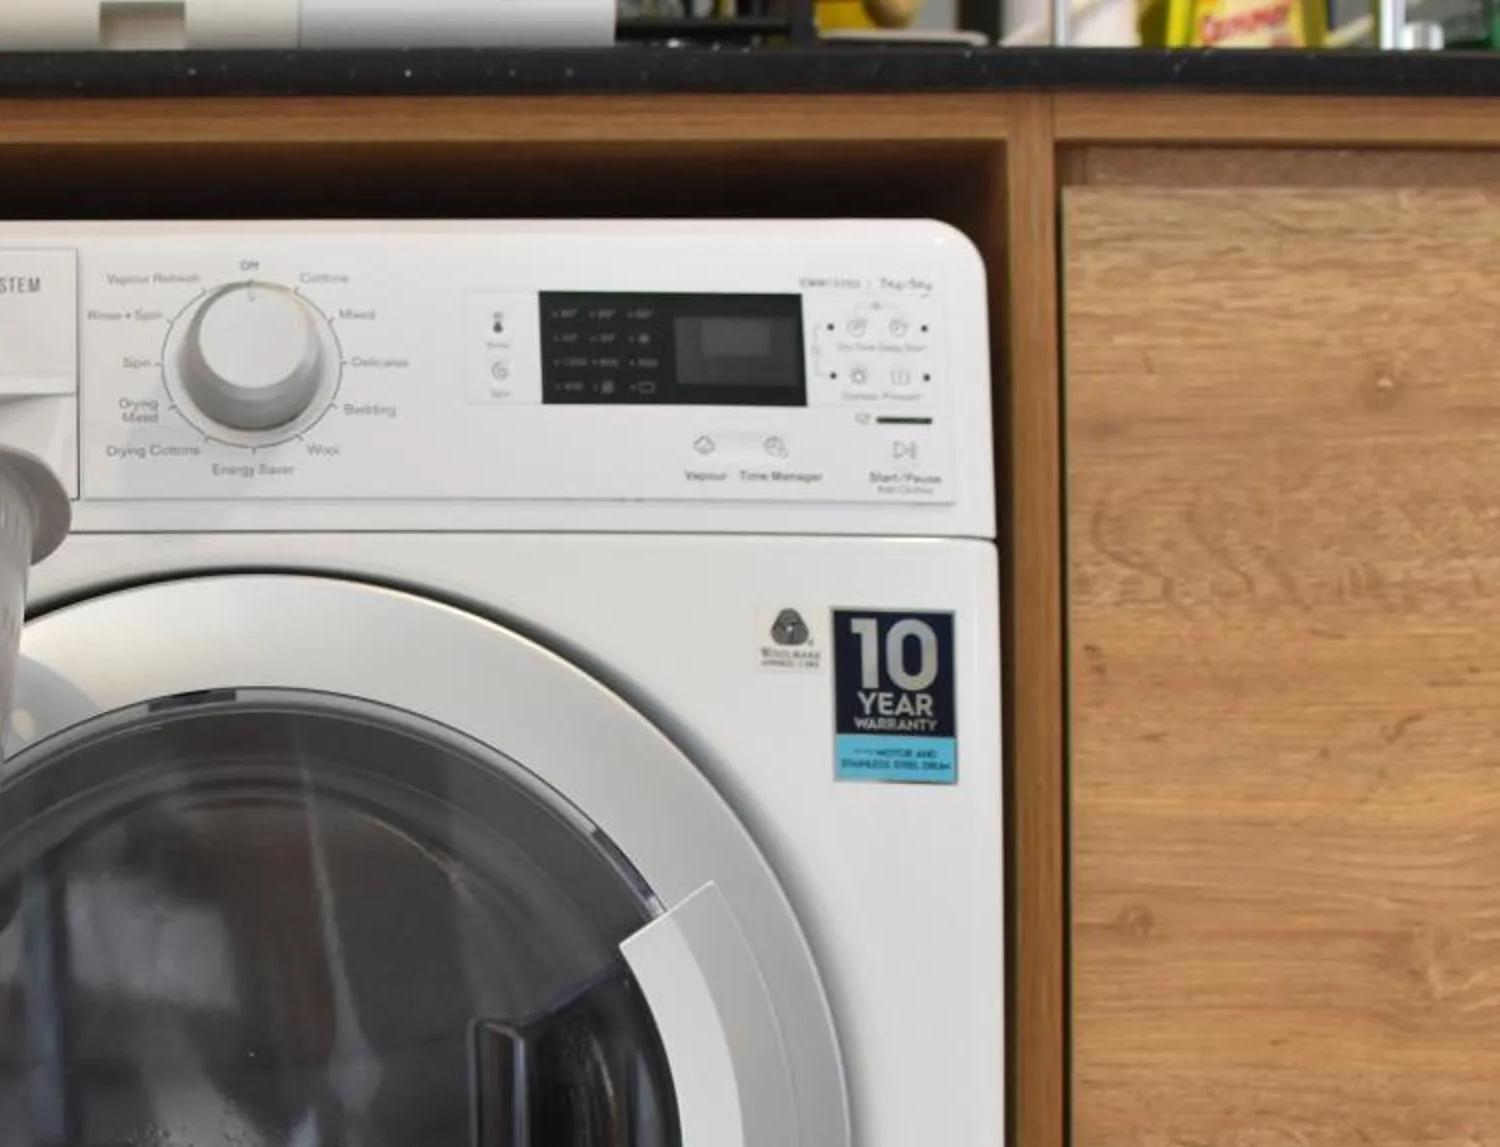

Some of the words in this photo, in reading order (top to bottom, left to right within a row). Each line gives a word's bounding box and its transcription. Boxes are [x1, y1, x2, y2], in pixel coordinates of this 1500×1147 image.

[851, 618, 939, 691] 10
[857, 692, 933, 716] YEAR
[854, 717, 938, 731] WARRANTY
